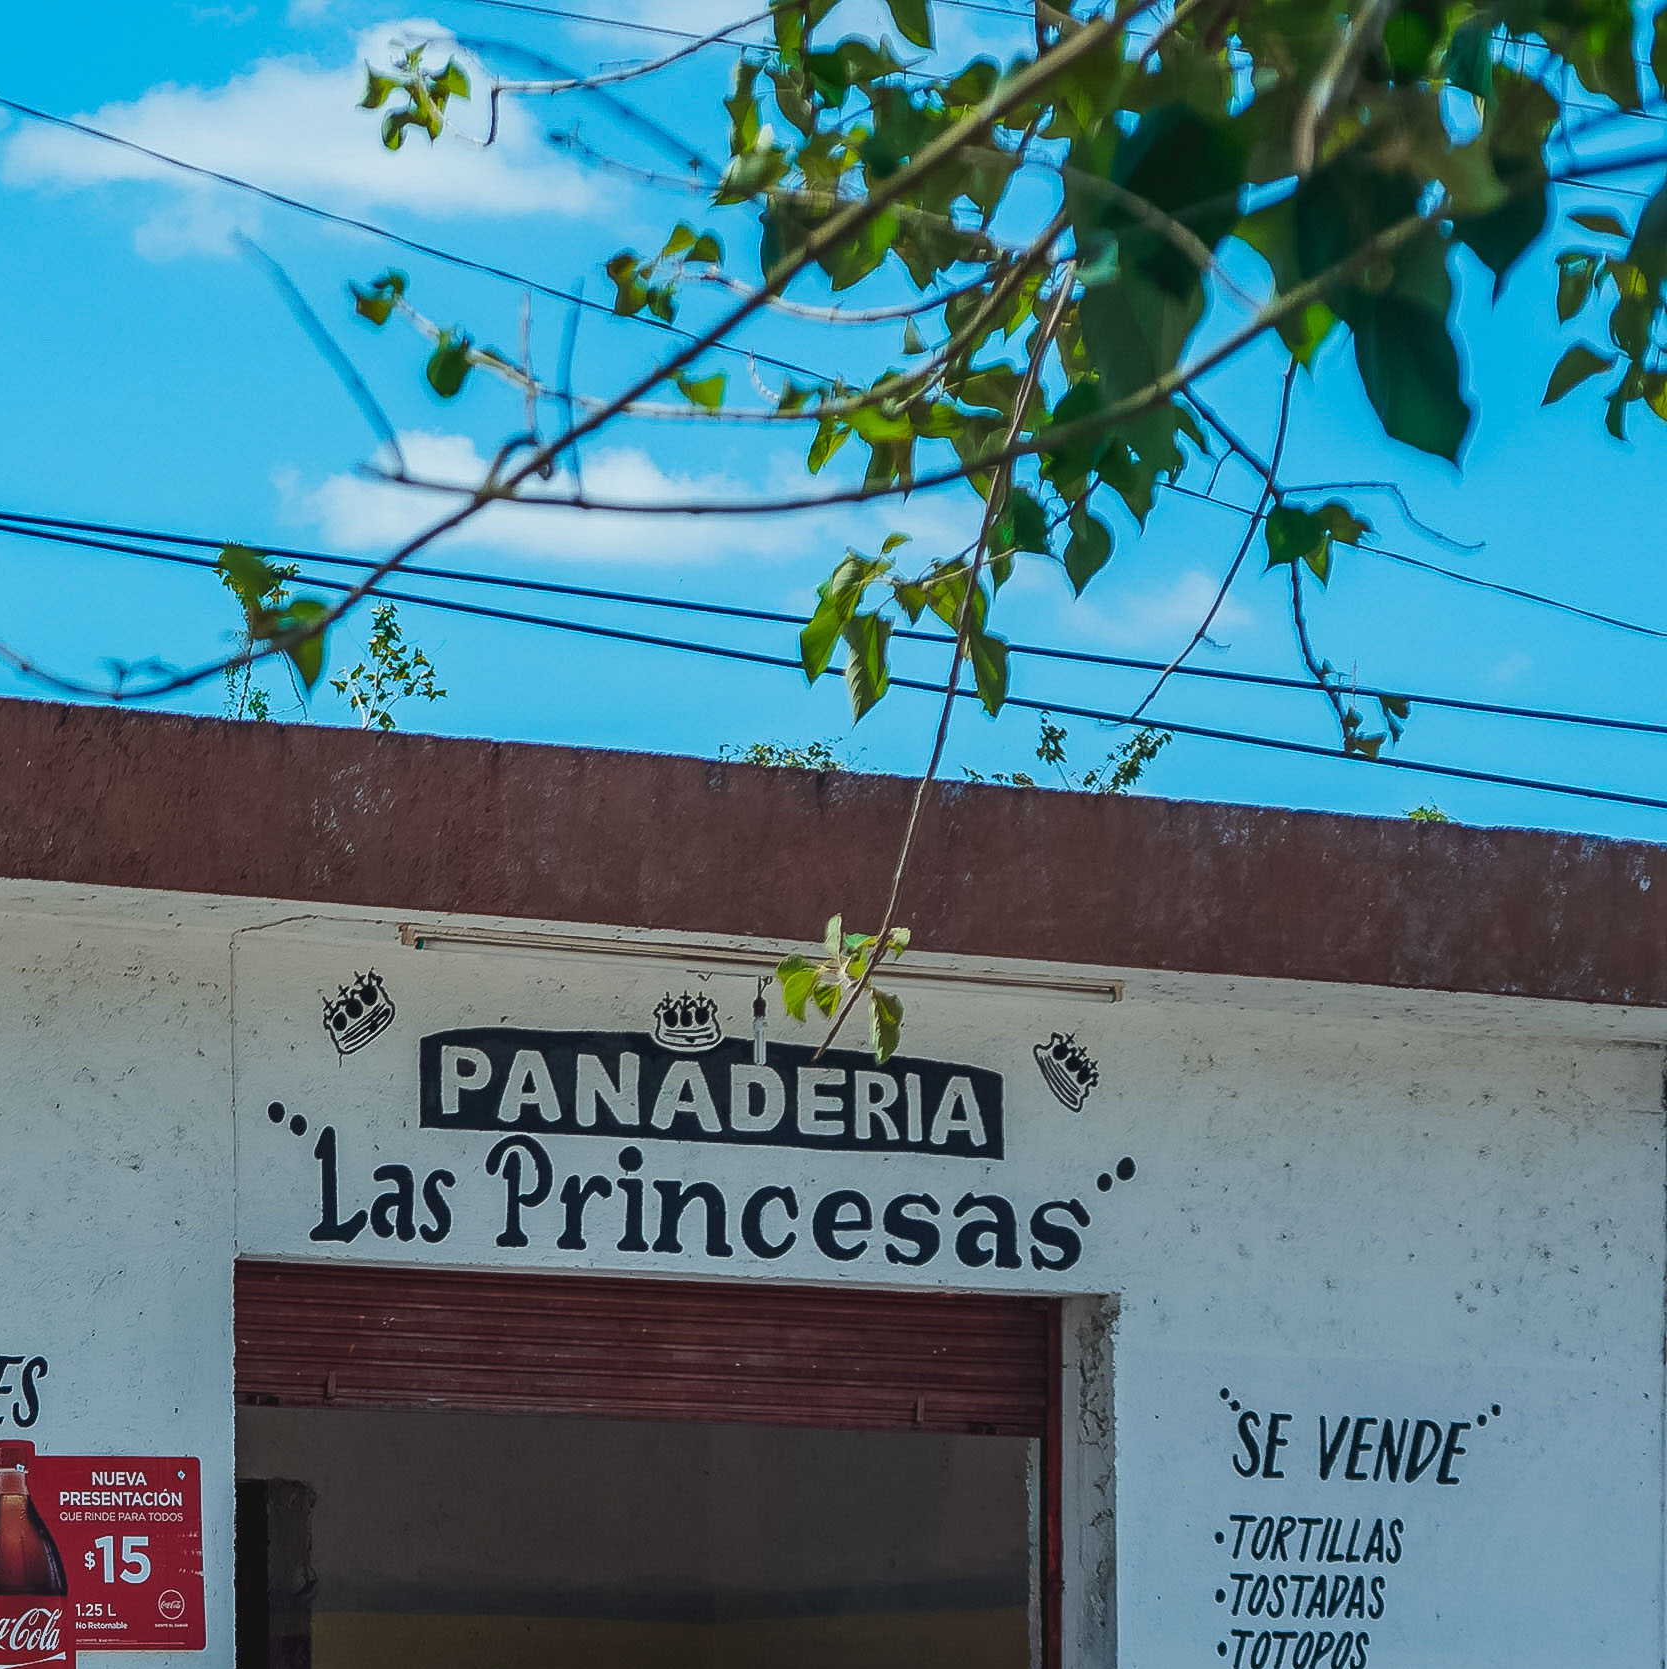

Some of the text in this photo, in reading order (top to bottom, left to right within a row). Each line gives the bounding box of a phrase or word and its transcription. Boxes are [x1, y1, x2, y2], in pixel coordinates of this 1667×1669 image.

[439, 1044, 989, 1148] PANADERIA
[91, 1471, 147, 1486] NUEVA
[59, 1488, 183, 1506] PRESENTACIÓN
[59, 1511, 184, 1522] QUE RINDE PARA TODOS
[1229, 1514, 1404, 1565] TORTILLAS
[84, 1535, 151, 1584] $15
[1229, 1572, 1386, 1620] TOSTADAS
[75, 1603, 116, 1617] 1.25 L
[75, 1622, 87, 1630] No
